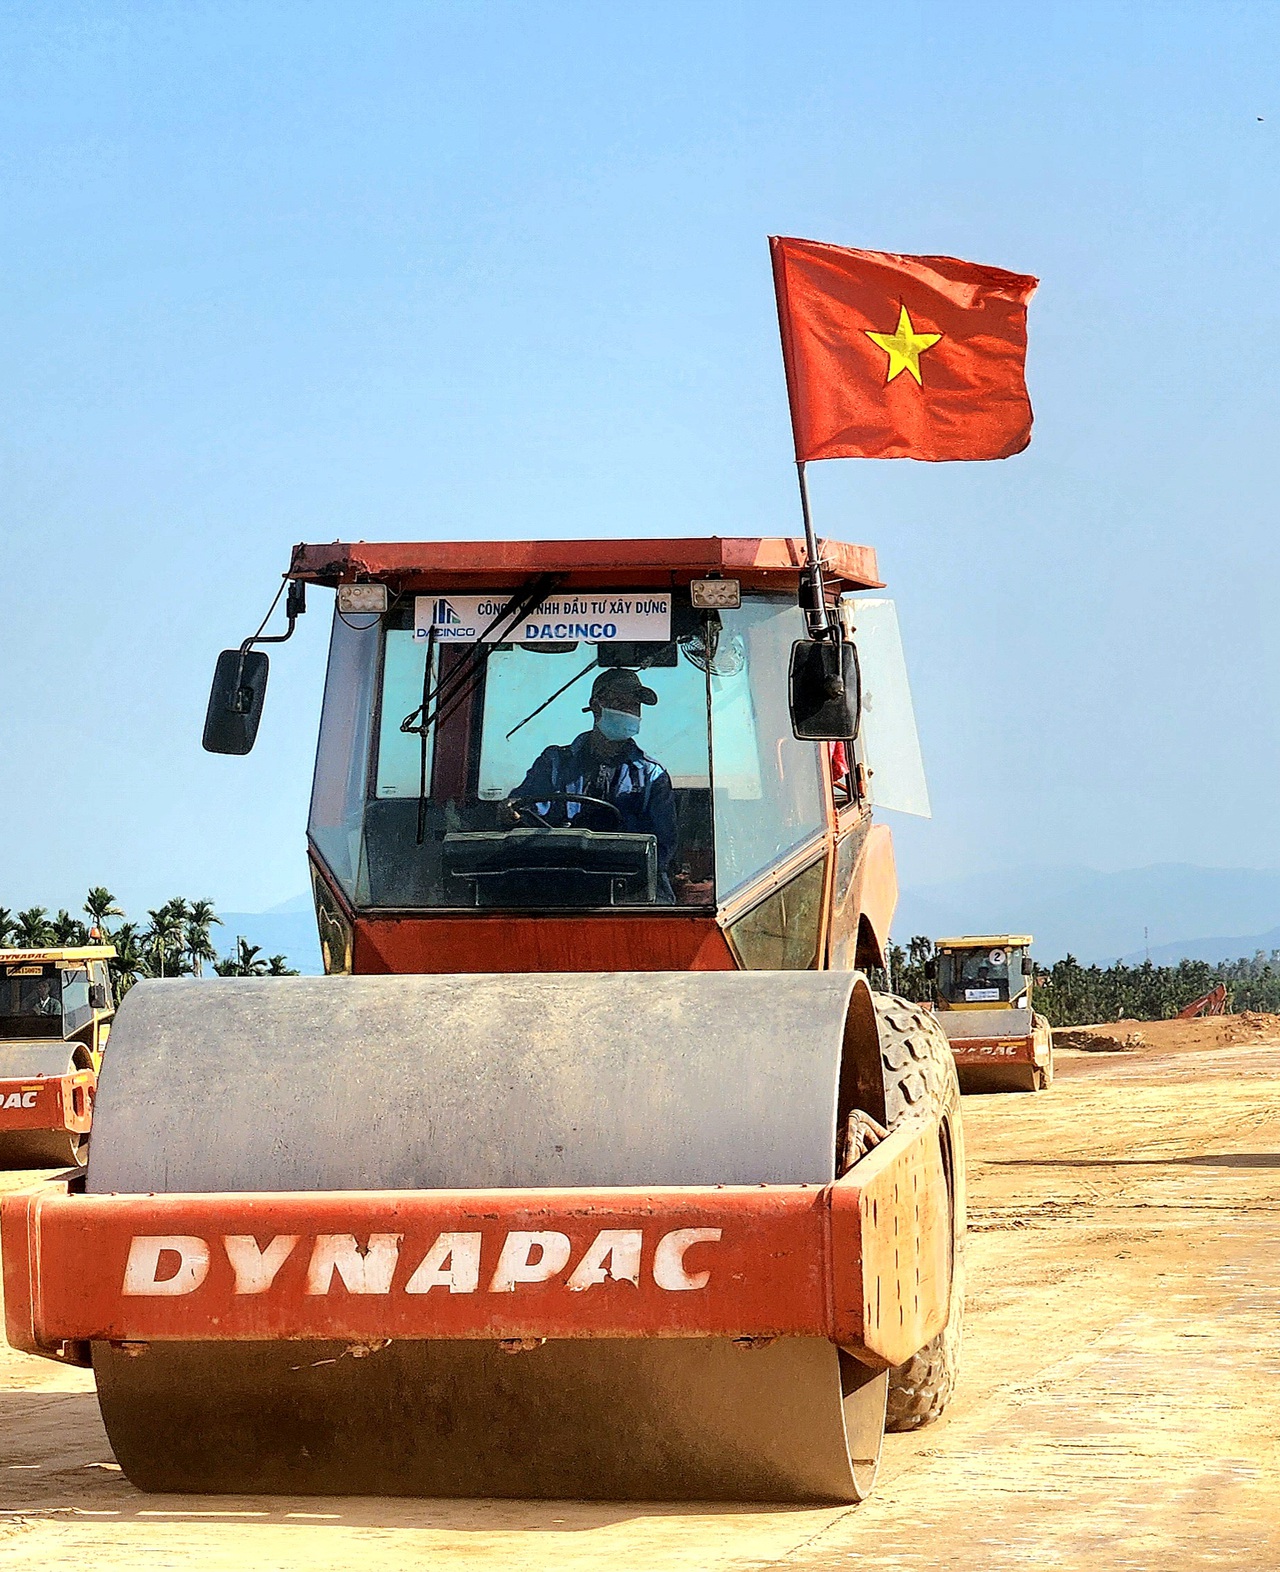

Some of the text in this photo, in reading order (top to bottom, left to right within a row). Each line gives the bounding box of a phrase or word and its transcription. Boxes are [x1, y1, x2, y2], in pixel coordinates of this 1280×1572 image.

[529, 602, 560, 615] NHH
[563, 597, 588, 615] ĐẦU
[591, 600, 607, 614] TƯ
[609, 598, 632, 614] XÂY
[635, 600, 667, 616] DỰNG
[417, 628, 476, 637] DCINCO
[525, 623, 617, 638] DACINCO
[993, 952, 1001, 962] 2
[121, 1227, 723, 1296] DYNAPAC
